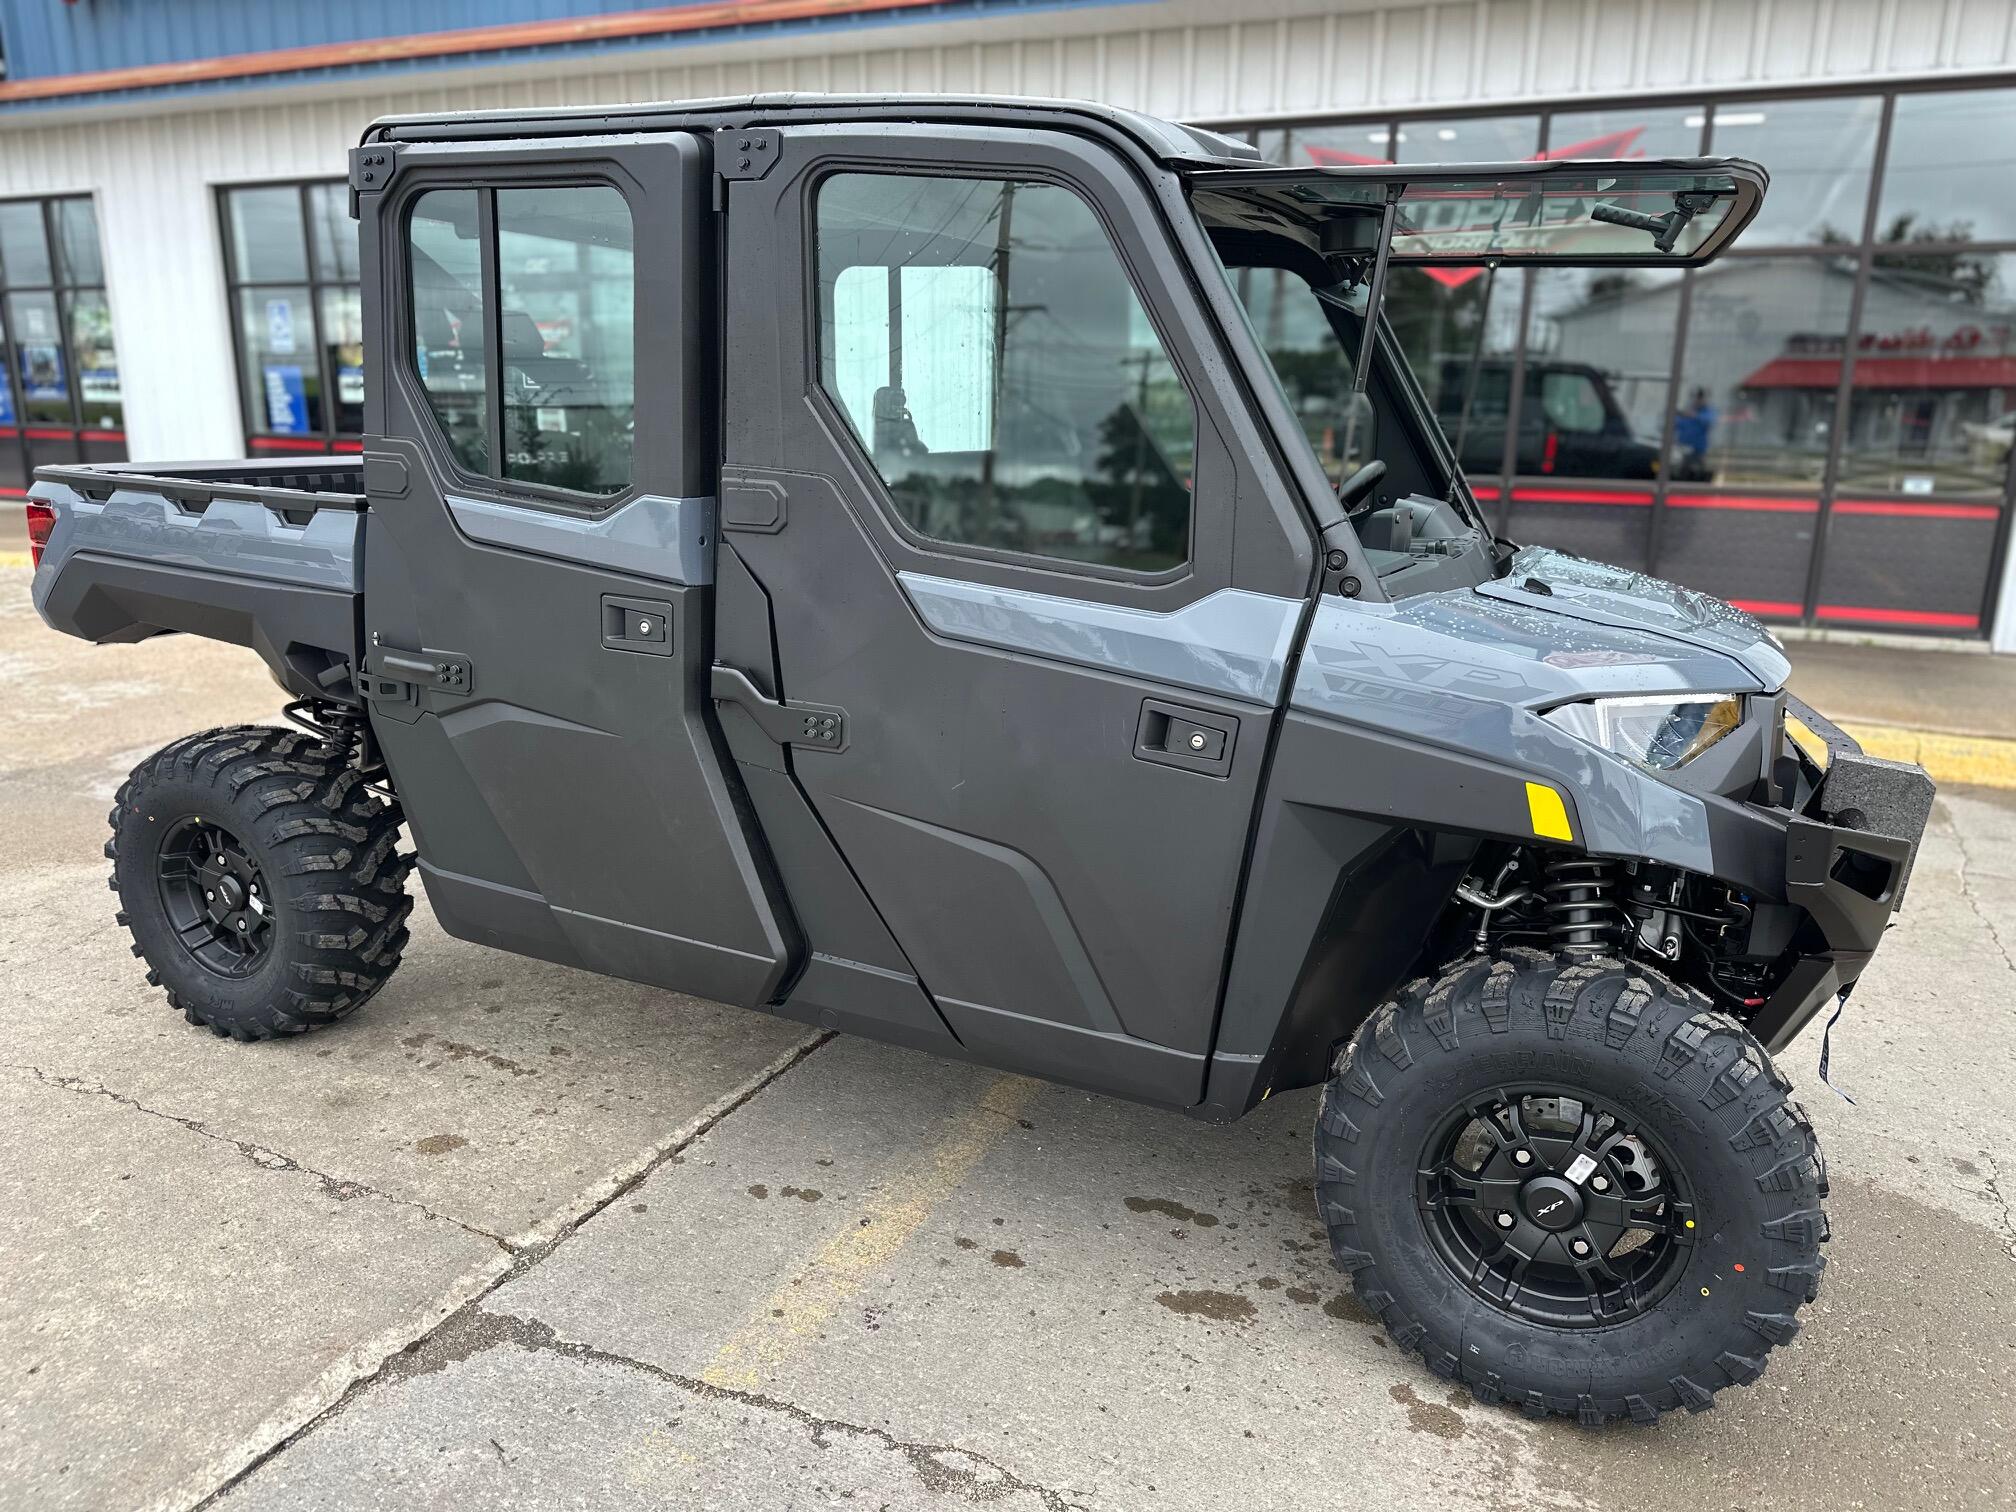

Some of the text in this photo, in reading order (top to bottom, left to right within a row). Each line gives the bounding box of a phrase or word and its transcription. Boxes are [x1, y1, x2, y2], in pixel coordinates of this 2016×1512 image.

[1394, 196, 1621, 233] TOPLEX
[1311, 641, 1554, 703] XP
[1336, 677, 1470, 717] 1000
[1536, 1200, 1564, 1218] XP
